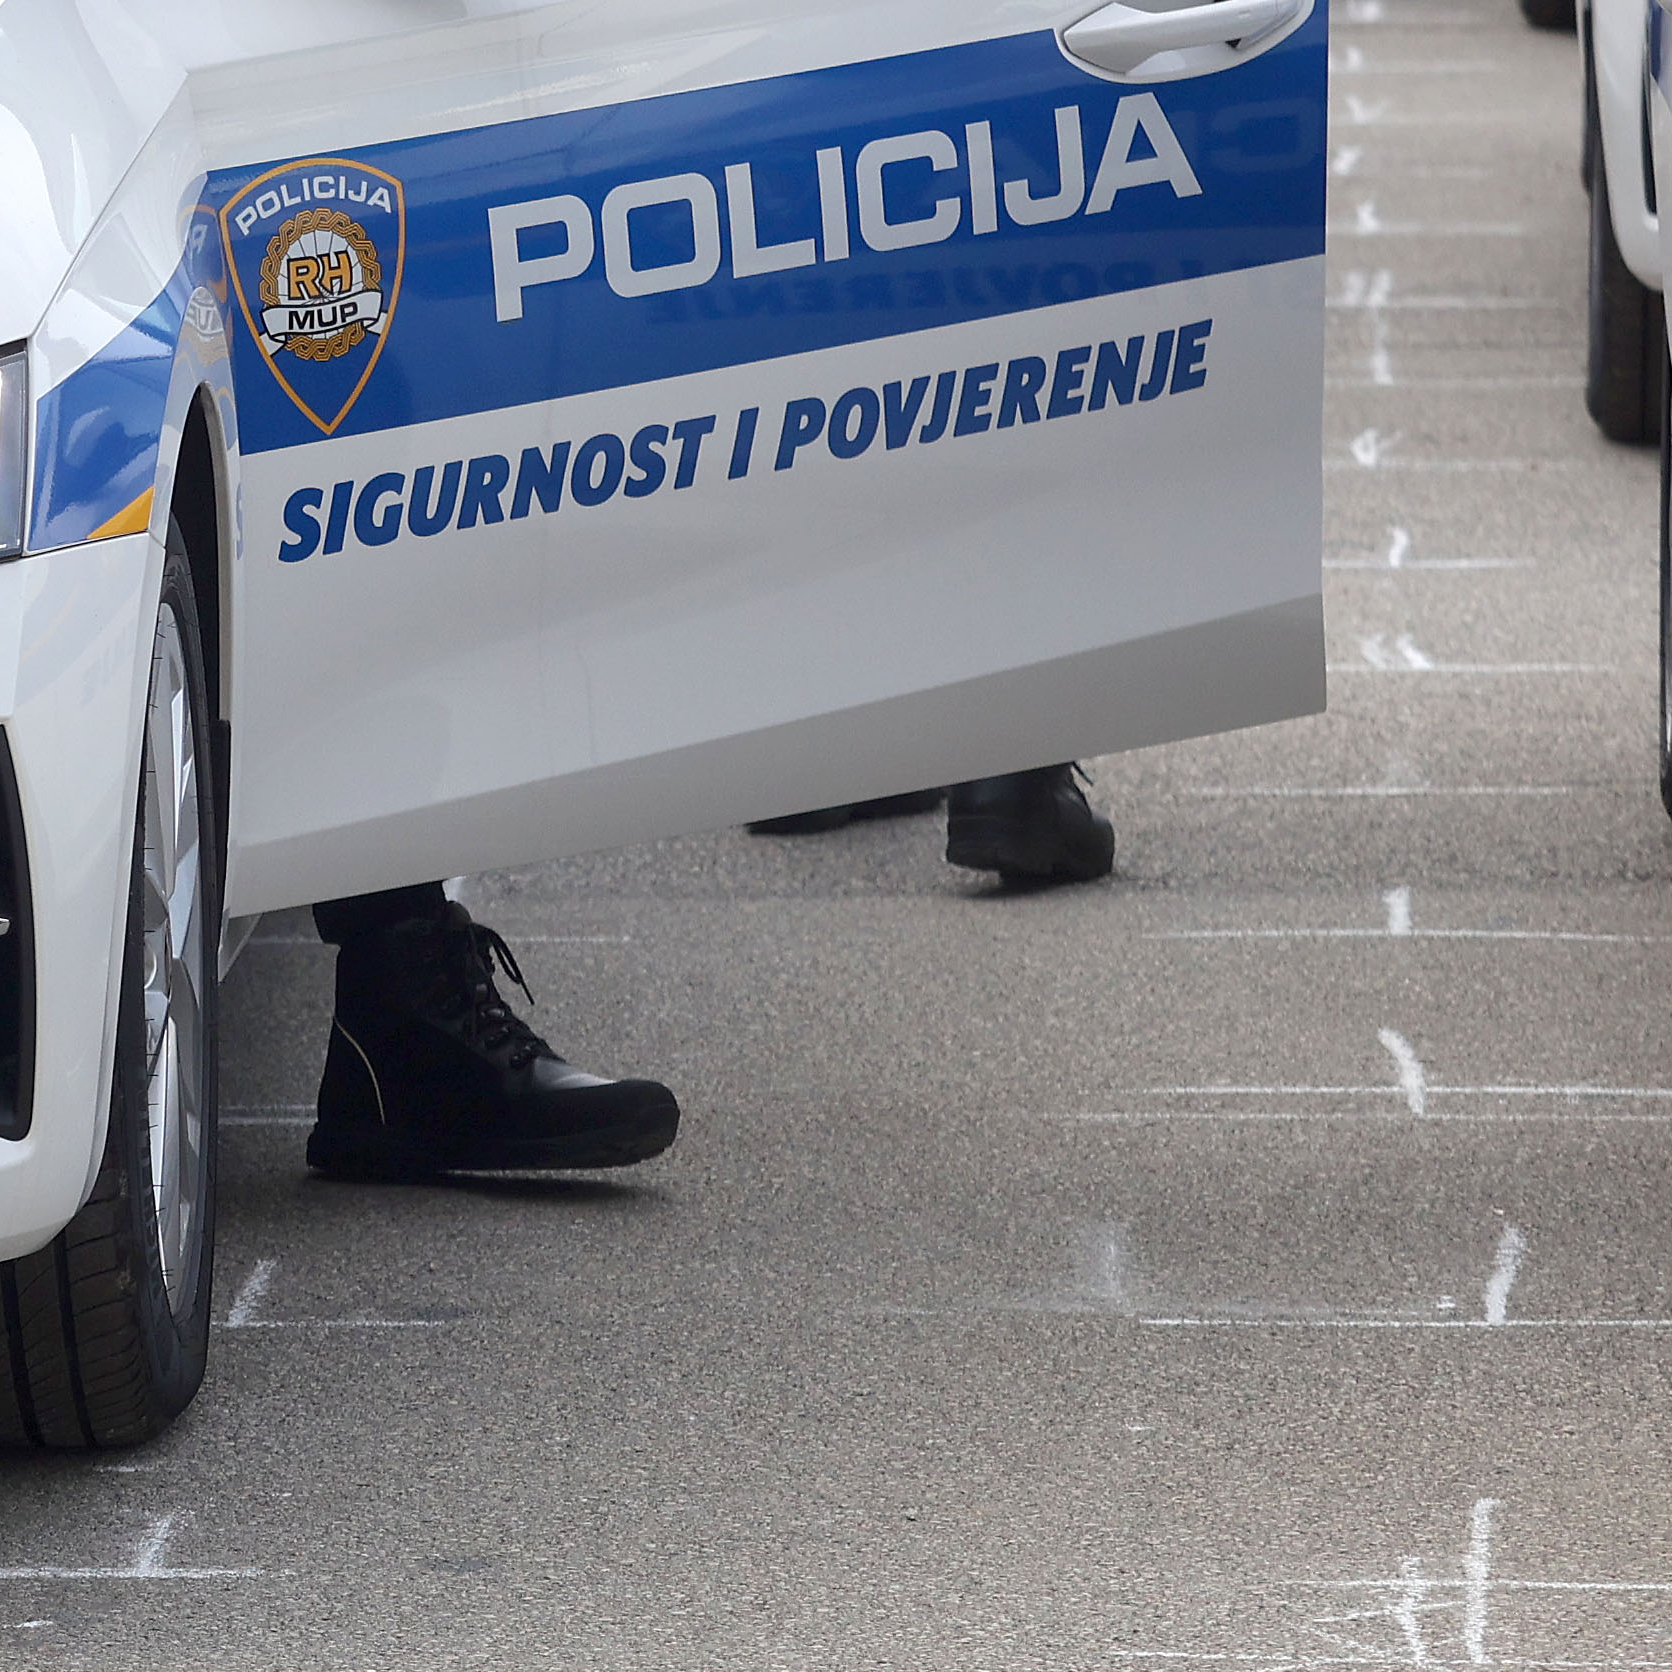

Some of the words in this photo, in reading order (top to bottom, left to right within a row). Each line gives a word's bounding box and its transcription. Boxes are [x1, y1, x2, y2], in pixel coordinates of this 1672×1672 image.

[235, 175, 392, 236] POLICIJA
[486, 91, 1203, 324] POLICIJA
[287, 250, 354, 301] RH
[288, 302, 359, 330] MUP
[277, 414, 715, 565] SIGURNOST
[727, 407, 759, 481] I
[774, 318, 1214, 471] POVJERENJE
